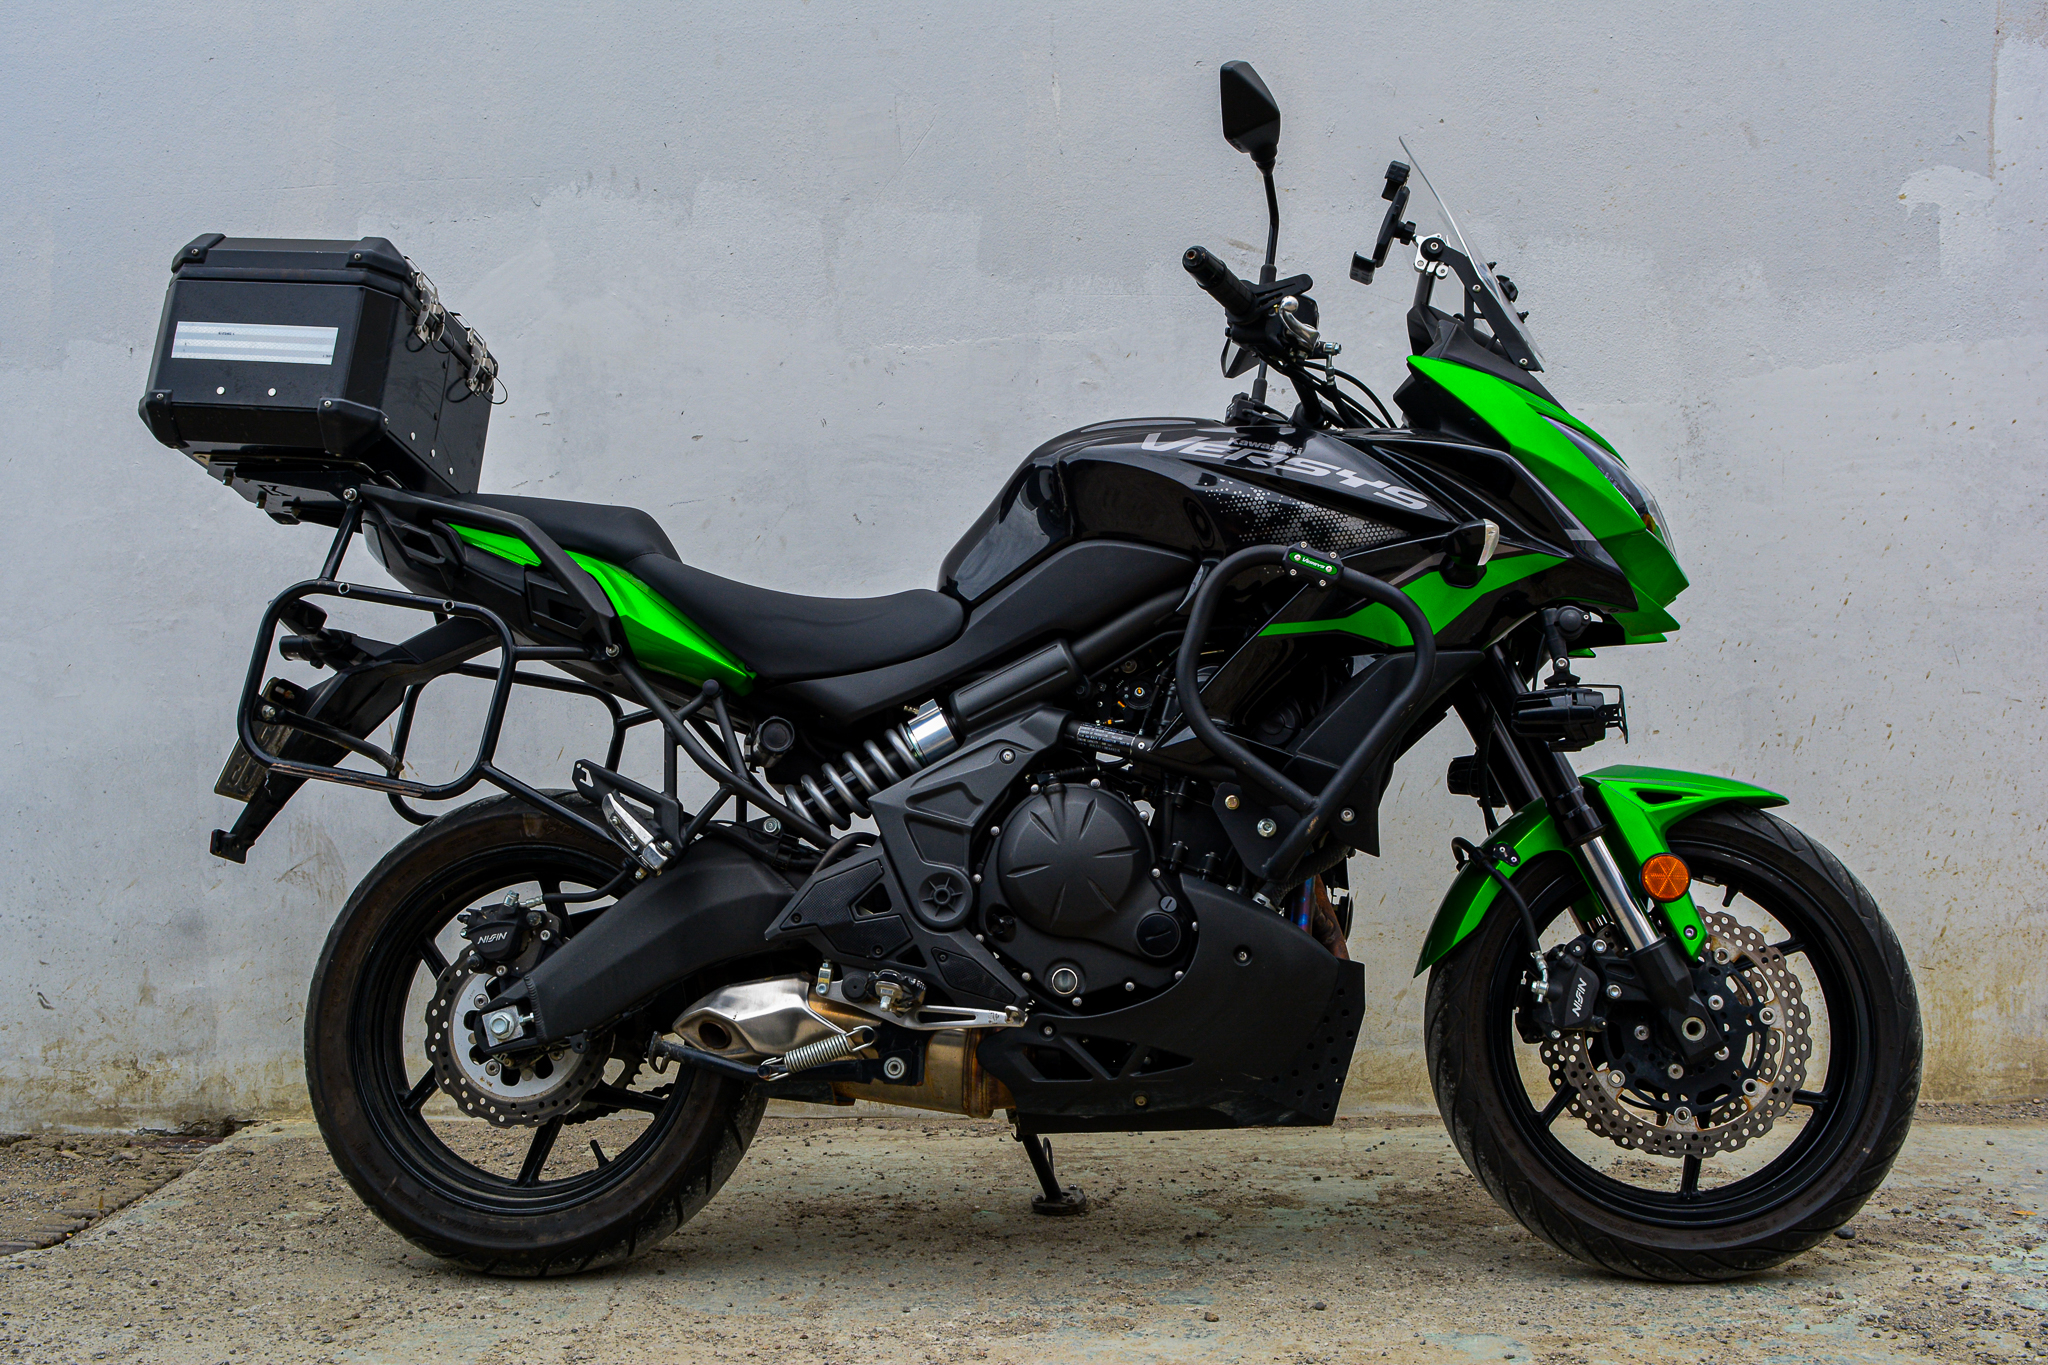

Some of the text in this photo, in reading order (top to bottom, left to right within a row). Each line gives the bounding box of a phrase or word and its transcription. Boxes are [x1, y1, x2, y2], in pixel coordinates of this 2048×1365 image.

[1227, 437, 1303, 456] Kawasaki
[1141, 432, 1431, 510] VERSYS
[477, 931, 508, 945] NISSIN
[1571, 977, 1588, 1018] NISSIN
